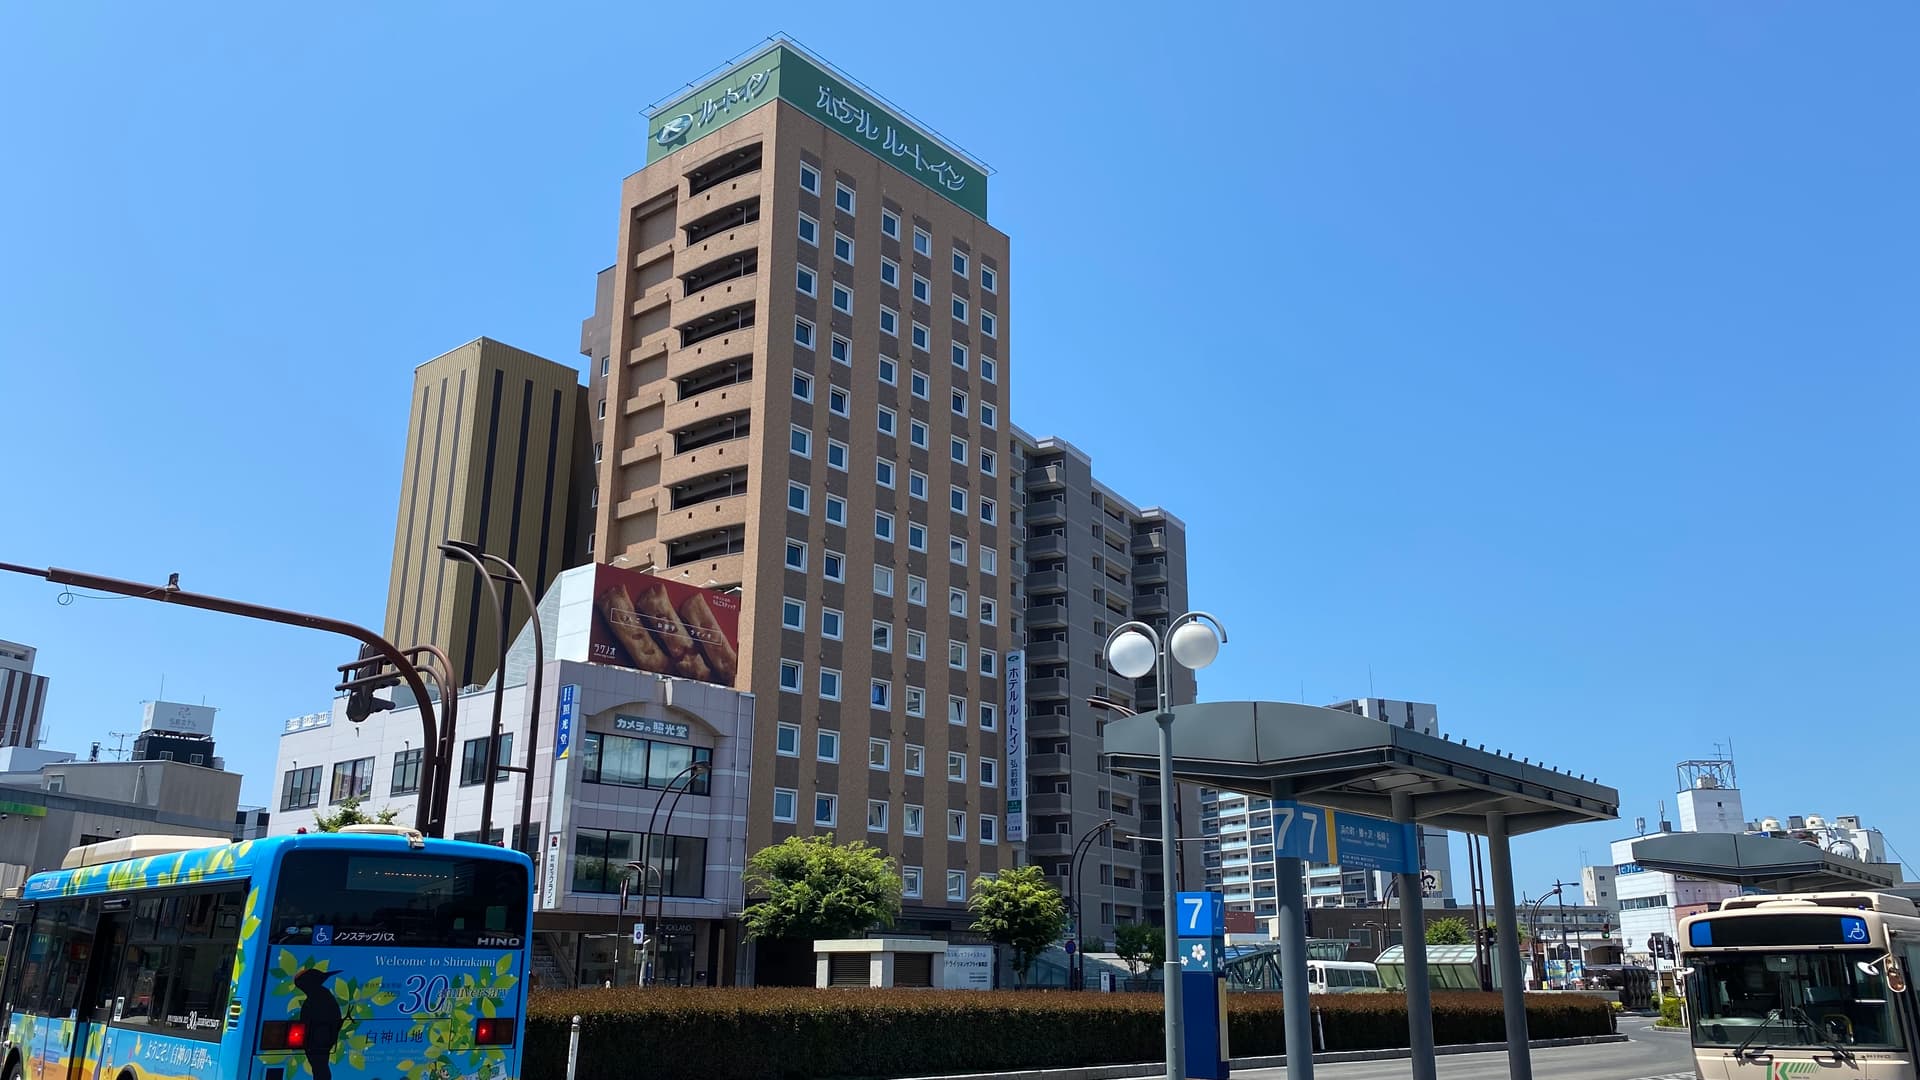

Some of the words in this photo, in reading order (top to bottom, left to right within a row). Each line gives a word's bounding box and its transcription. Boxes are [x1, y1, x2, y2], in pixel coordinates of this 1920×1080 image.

[697, 68, 771, 127] ルートイン
[1272, 808, 1294, 850] 7
[1302, 812, 1318, 854] 7
[1183, 898, 1203, 929] 7
[1213, 899, 1222, 919] 7
[334, 931, 395, 943] ノンステップバス
[477, 936, 521, 947] HINO
[375, 955, 427, 968] Welcome
[429, 957, 440, 967] to
[442, 956, 497, 968] Shirakami
[437, 985, 509, 1001] anniversary
[365, 1029, 424, 1045] 白神山地
